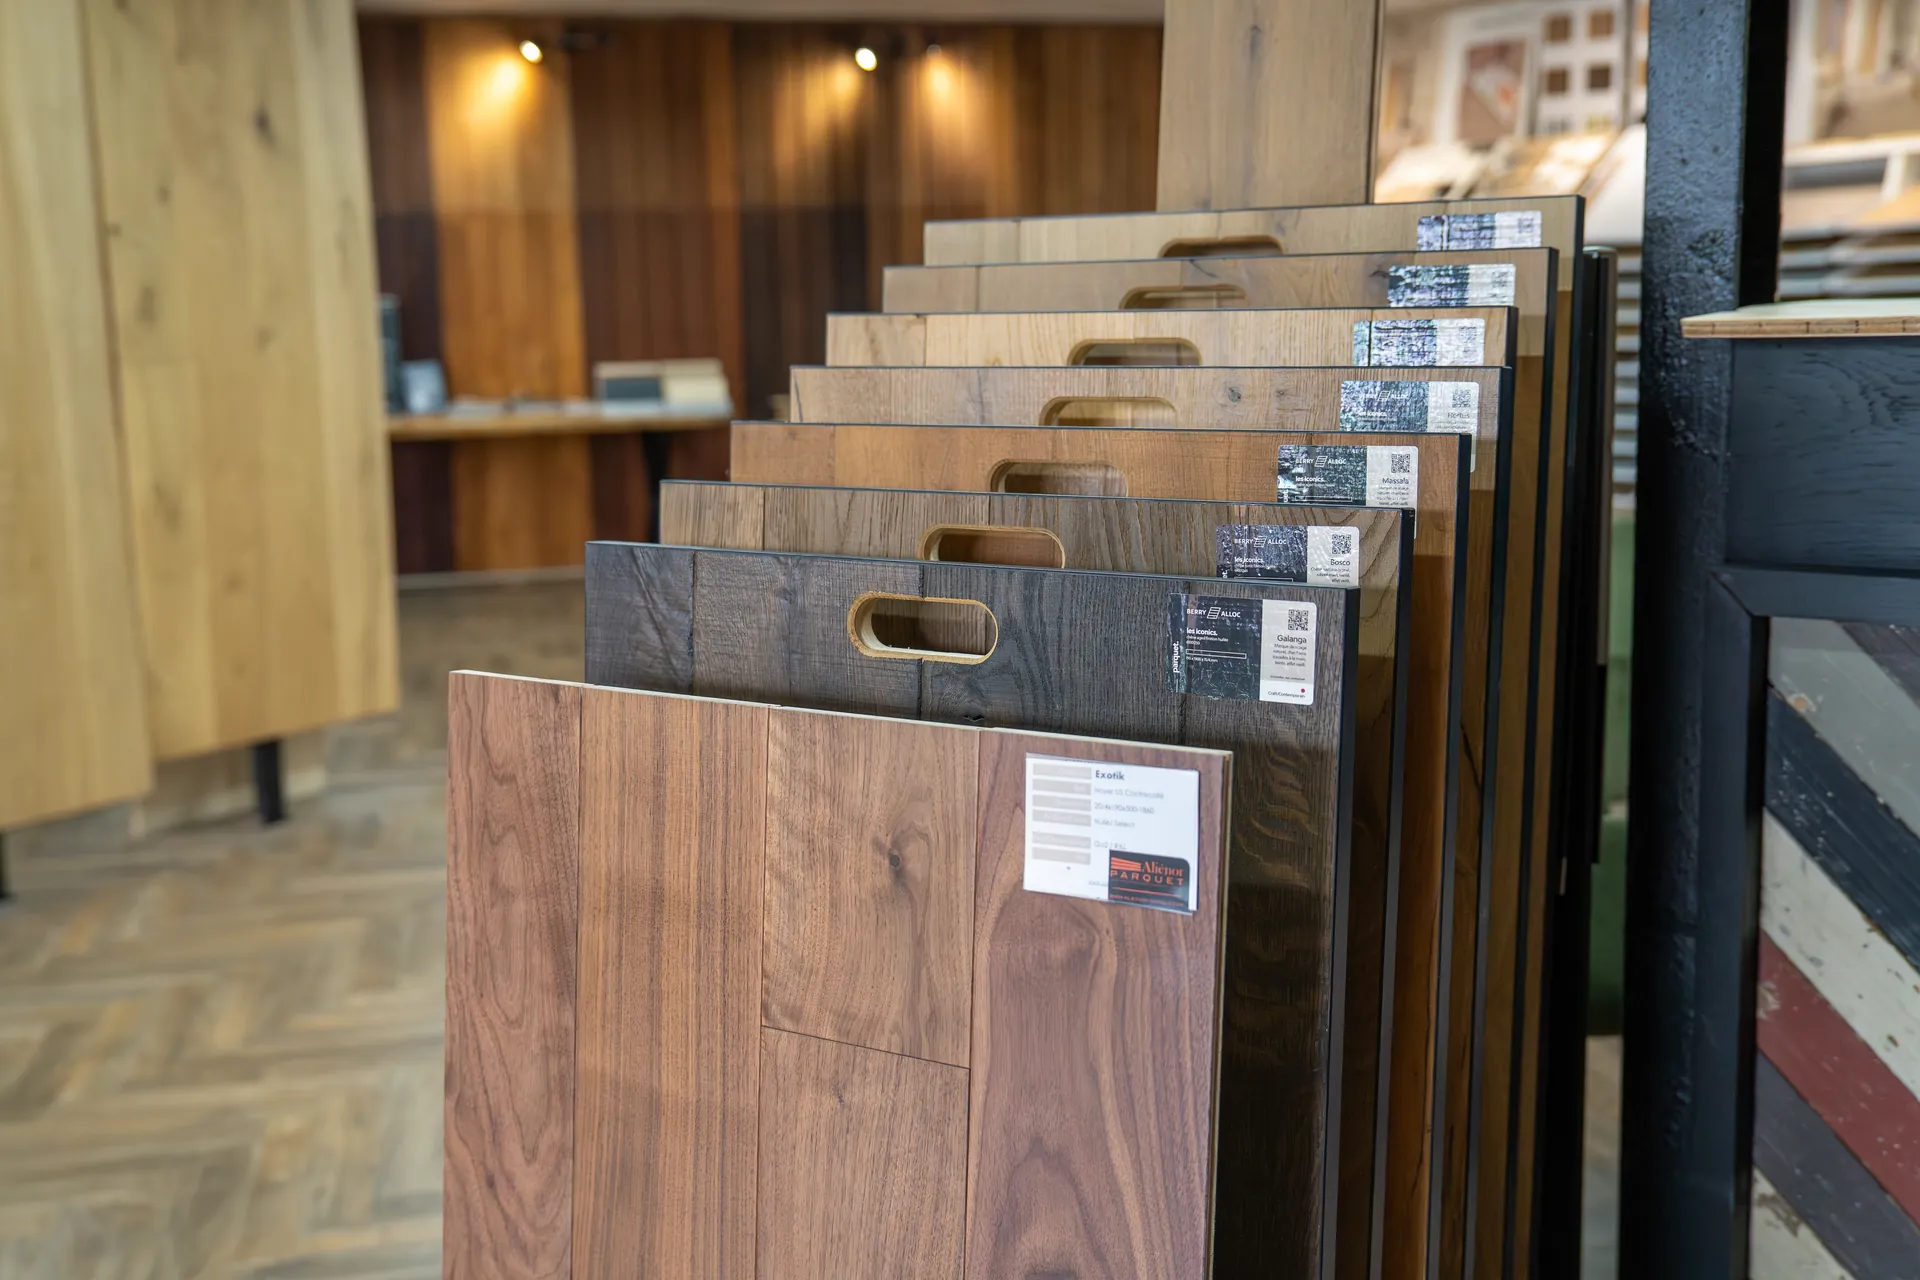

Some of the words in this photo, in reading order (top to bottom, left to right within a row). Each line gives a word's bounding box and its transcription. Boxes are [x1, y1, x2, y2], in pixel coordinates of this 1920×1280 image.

[1330, 558, 1350, 566] Bosco
[1186, 608, 1207, 616] BERRY
[1276, 634, 1307, 645] Galanga
[1172, 641, 1181, 674] parquet.
[1095, 769, 1125, 780] Exotik
[1110, 869, 1184, 886] PARQUET
